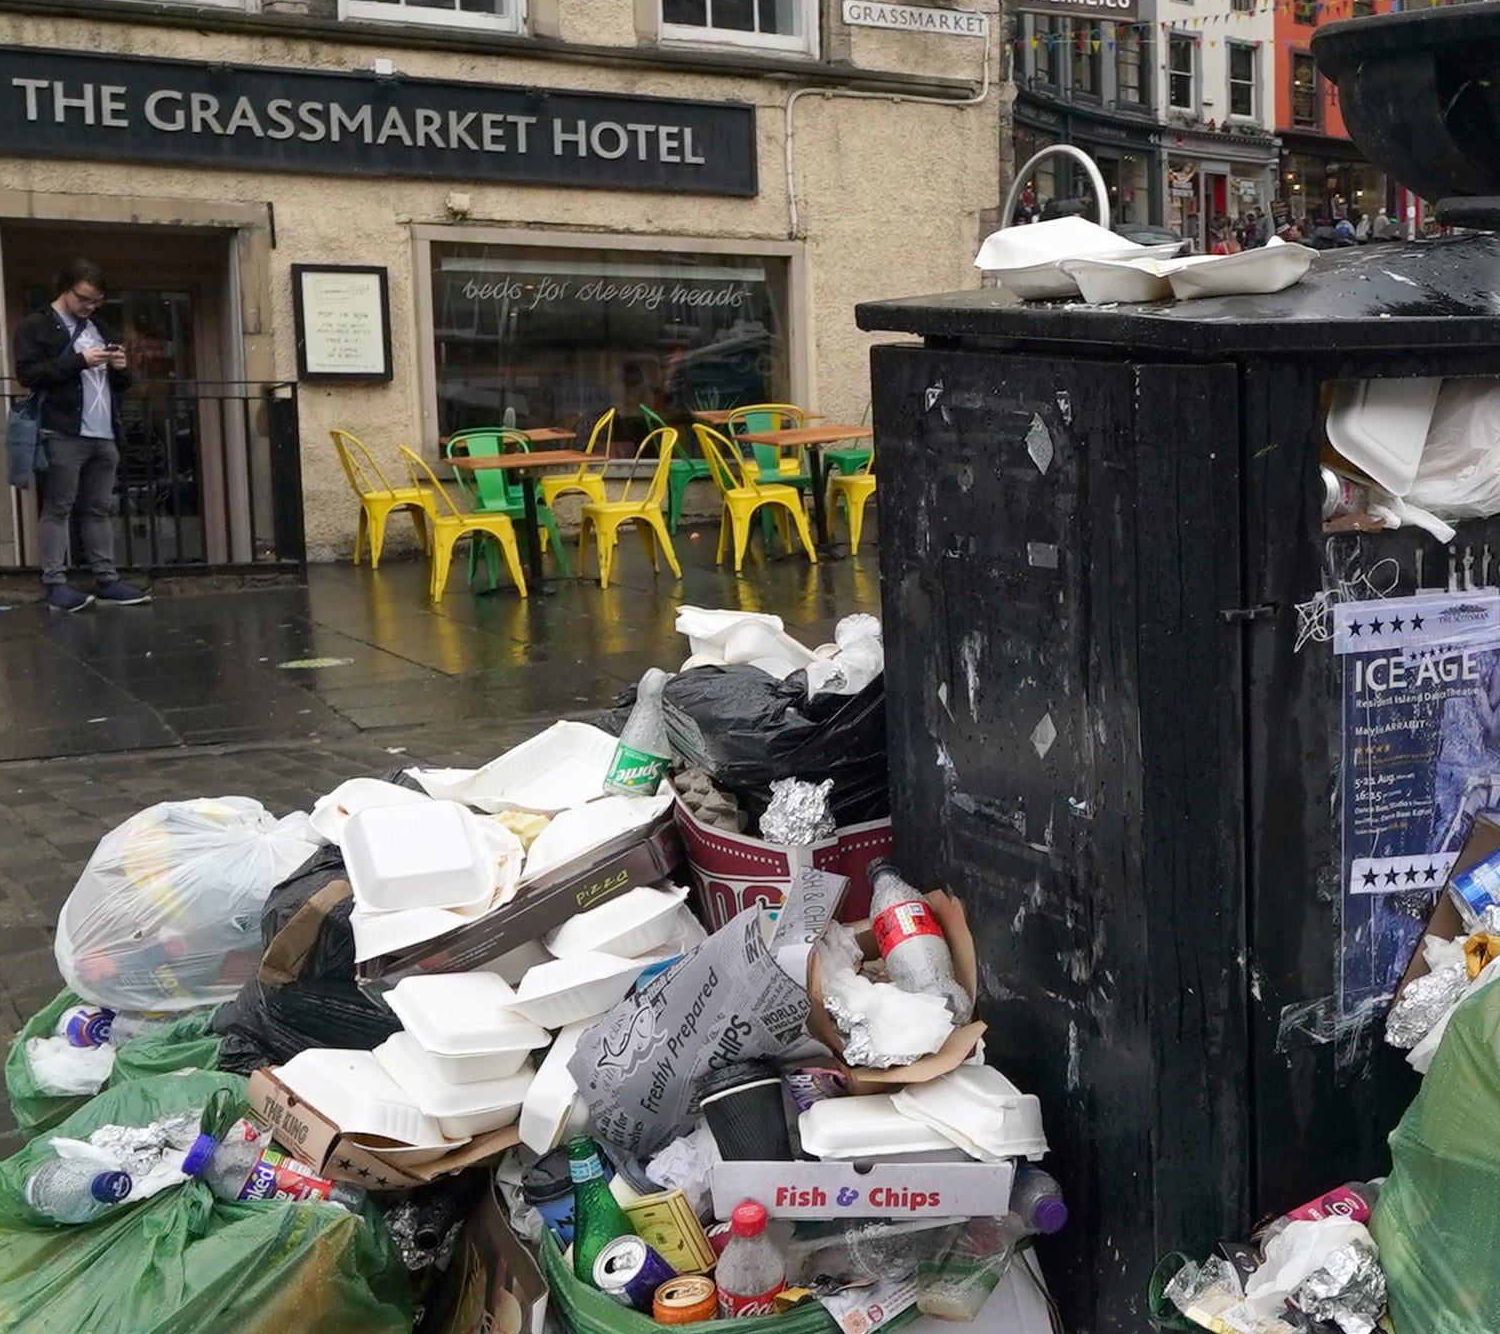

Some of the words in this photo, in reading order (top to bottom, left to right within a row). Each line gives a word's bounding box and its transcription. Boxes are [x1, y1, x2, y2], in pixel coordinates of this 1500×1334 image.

[849, 5, 985, 36] GRASSMARKET
[11, 77, 130, 129] THE
[144, 88, 537, 155] GRASSMARKET
[552, 117, 706, 165] HOTEL
[462, 275, 522, 300] beds
[528, 278, 572, 310] for
[575, 279, 665, 310] sleepy
[669, 281, 743, 308] heads
[1355, 655, 1407, 693] ICE
[1416, 649, 1480, 687] AGE
[616, 760, 663, 786] Sprite
[575, 869, 629, 905] pizza
[803, 906, 825, 945] CHIPS
[760, 1004, 797, 1027] WORLD
[641, 1056, 678, 1115] Freshly
[667, 967, 719, 1059] Prepared
[707, 1014, 753, 1069] CHIPS
[264, 1097, 284, 1124] THE
[283, 1109, 309, 1145] KING
[775, 1185, 827, 1208] Fish
[836, 1186, 860, 1207] &
[869, 1185, 941, 1212] Chips
